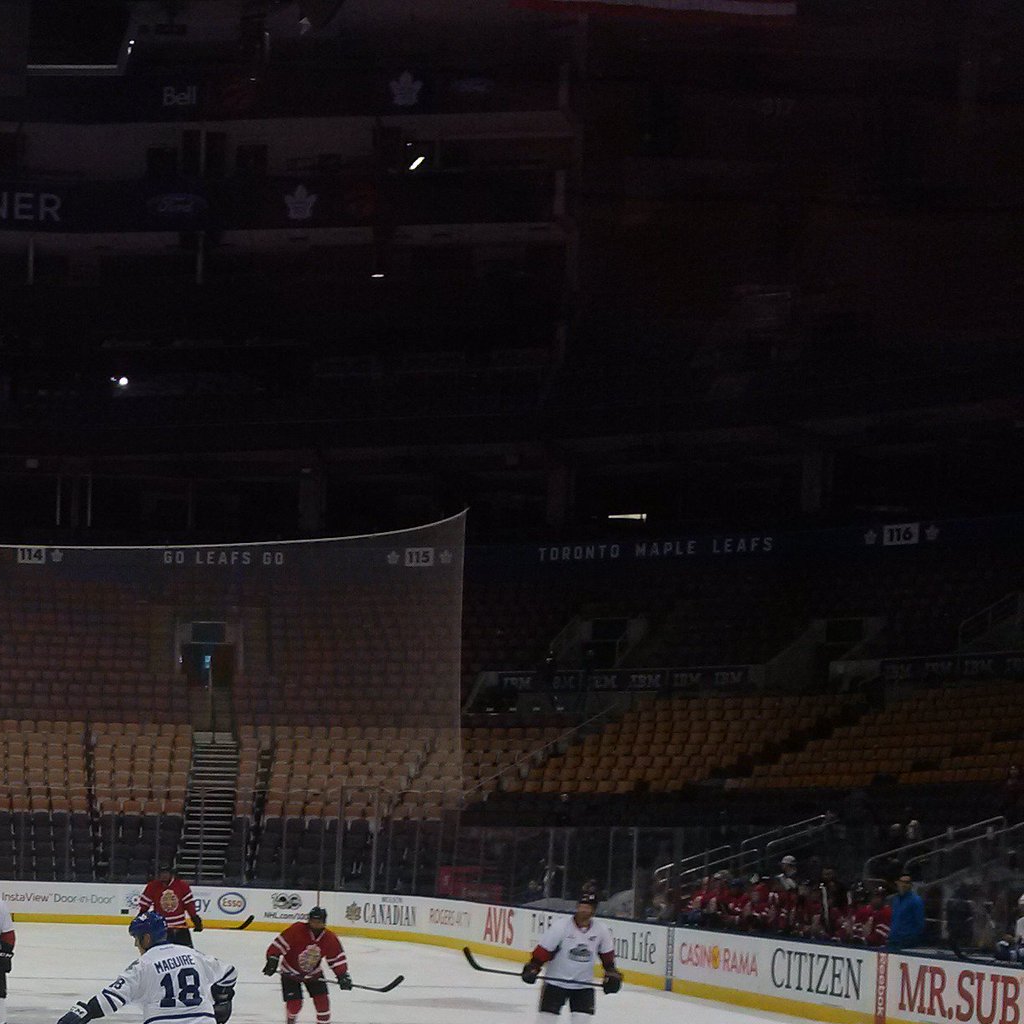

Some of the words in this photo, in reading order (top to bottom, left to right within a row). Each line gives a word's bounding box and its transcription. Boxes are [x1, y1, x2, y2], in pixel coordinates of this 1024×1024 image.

[163, 86, 197, 105] Bell
[888, 526, 913, 542] 116
[19, 548, 43, 560] 114
[163, 550, 185, 564] GO
[195, 551, 251, 565] LEAFS
[262, 551, 284, 565] GO
[408, 551, 430, 563] 115
[538, 543, 620, 562] TORONTO
[635, 540, 697, 557] MAPLE
[712, 536, 774, 553] LEAFS
[630, 673, 661, 689] IBM
[363, 902, 417, 926] CANADIAN
[483, 906, 514, 945] AVIS
[632, 931, 656, 964] Life
[680, 942, 720, 970] CASINO
[722, 948, 758, 976] RAMA
[154, 954, 195, 974] MAGUIRE
[771, 948, 863, 1000] CITIZEN
[160, 968, 202, 1008] 18
[876, 953, 887, 1016] Reebok
